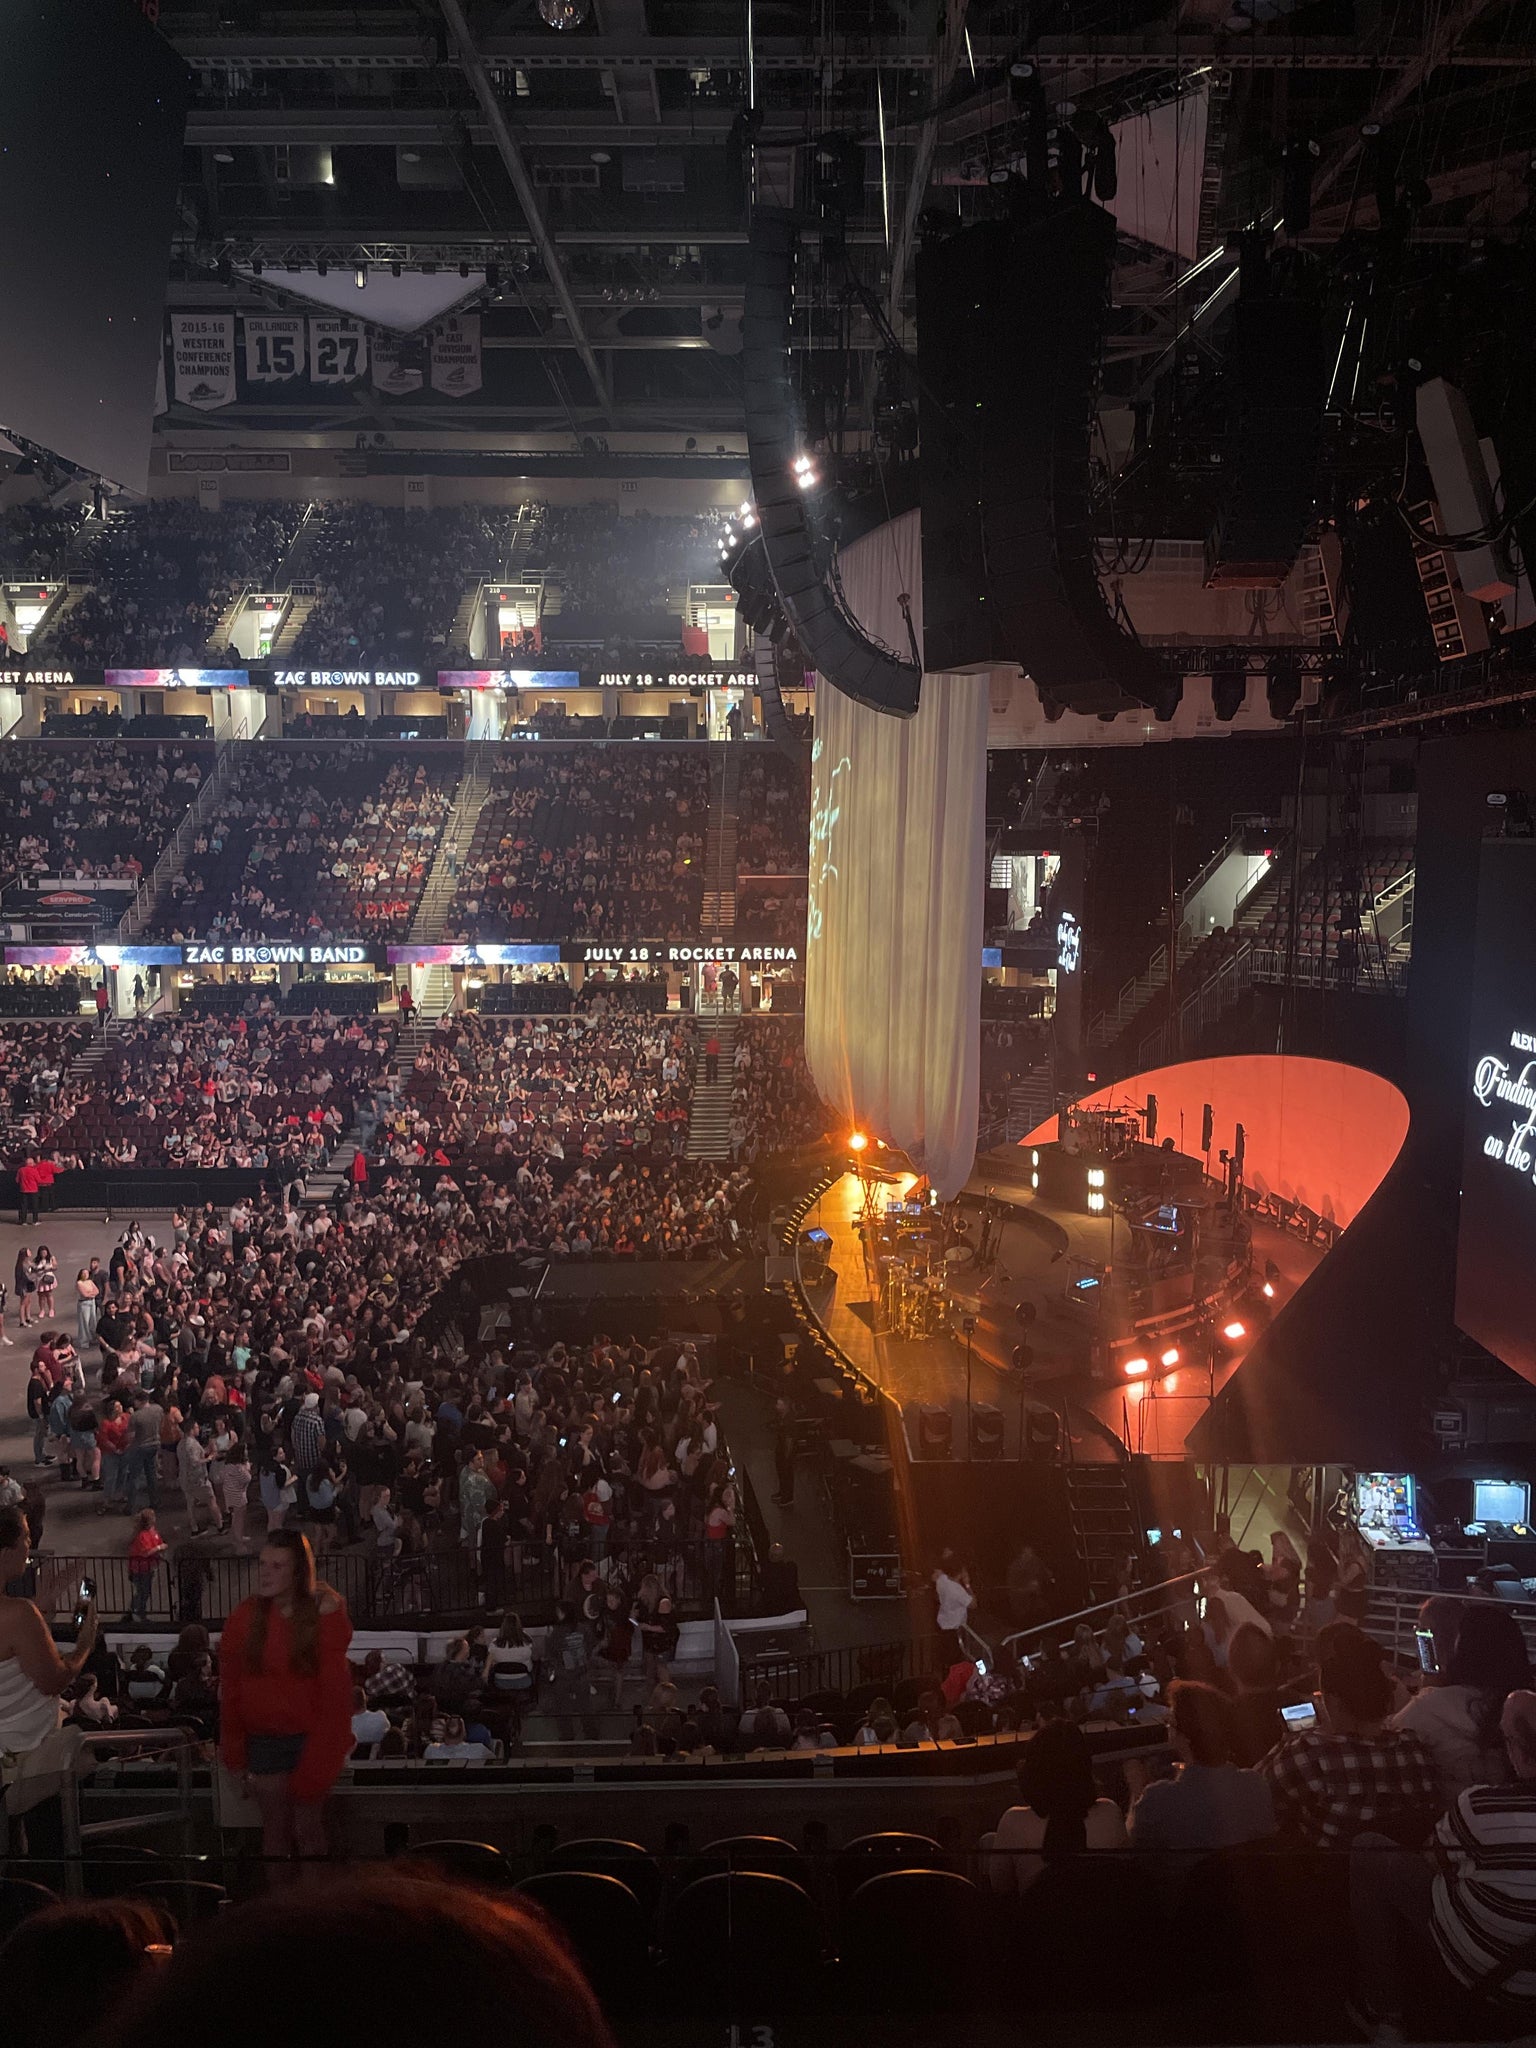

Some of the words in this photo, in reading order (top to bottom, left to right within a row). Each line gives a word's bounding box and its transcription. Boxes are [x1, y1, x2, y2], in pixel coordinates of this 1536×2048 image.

[181, 322, 225, 333] 2015-16
[249, 322, 298, 332] CALLANDER
[182, 337, 225, 349] WESTERN
[446, 333, 464, 343] EAST
[255, 336, 295, 374] 15
[438, 344, 473, 354] DIVISION
[176, 351, 232, 363] CONFERENCE
[317, 338, 359, 375] 27
[433, 354, 478, 364] CHAMPIONS
[179, 365, 230, 376] CHAMPIONS
[25, 672, 74, 684] ARENA
[274, 672, 306, 685] ZAC
[311, 671, 370, 685] BROWN
[375, 671, 421, 686] BAND
[599, 674, 632, 686] JULY
[637, 674, 653, 685] 18
[669, 674, 724, 685] ROCKET
[186, 947, 225, 963] ZAC
[232, 946, 305, 963] BROWN
[310, 946, 365, 963] BAND
[583, 948, 623, 961] JULY
[630, 948, 649, 961] 18
[669, 948, 735, 961] ROCKET
[741, 948, 797, 961] ARENA
[1510, 1031, 1532, 1051] ALEX
[1483, 1134, 1504, 1160] on
[1504, 1122, 1531, 1172] the
